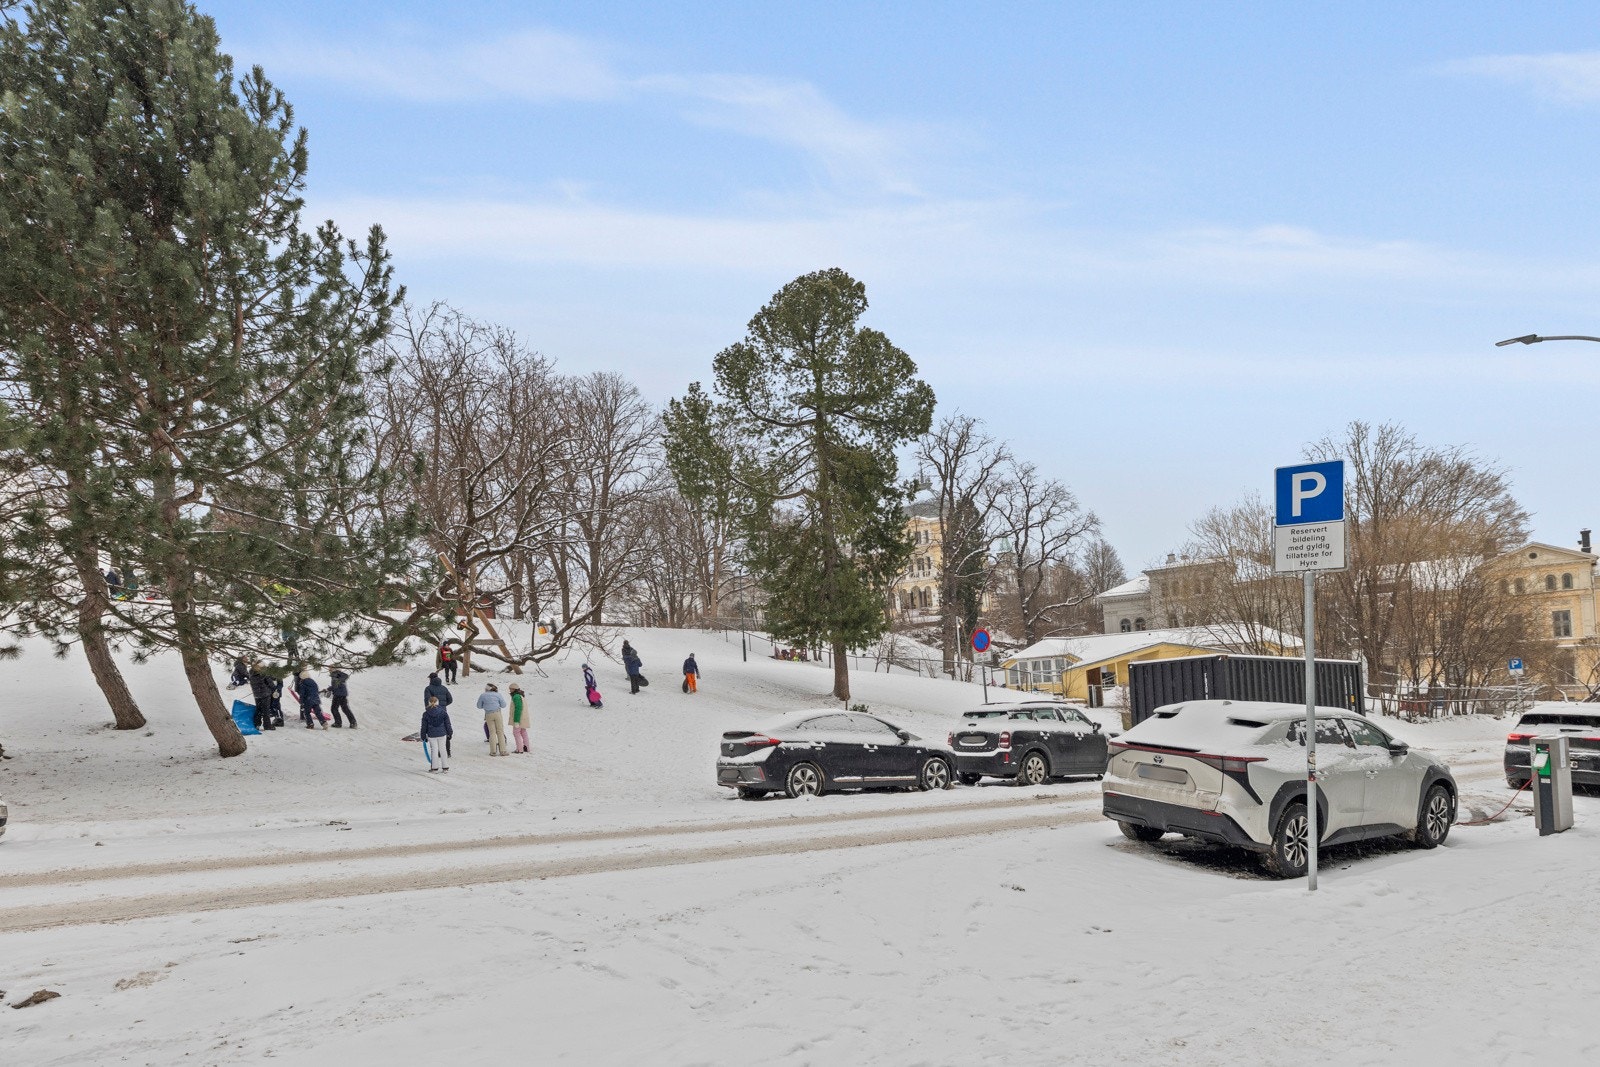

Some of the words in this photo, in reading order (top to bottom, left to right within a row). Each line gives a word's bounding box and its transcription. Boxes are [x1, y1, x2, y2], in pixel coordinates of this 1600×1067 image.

[1292, 471, 1327, 517] P
[1290, 526, 1327, 535] Reservert
[1292, 535, 1325, 543] bildeling
[1306, 543, 1330, 551] gyldig
[1286, 551, 1319, 559] tillatelse
[1511, 659, 1520, 668] P
